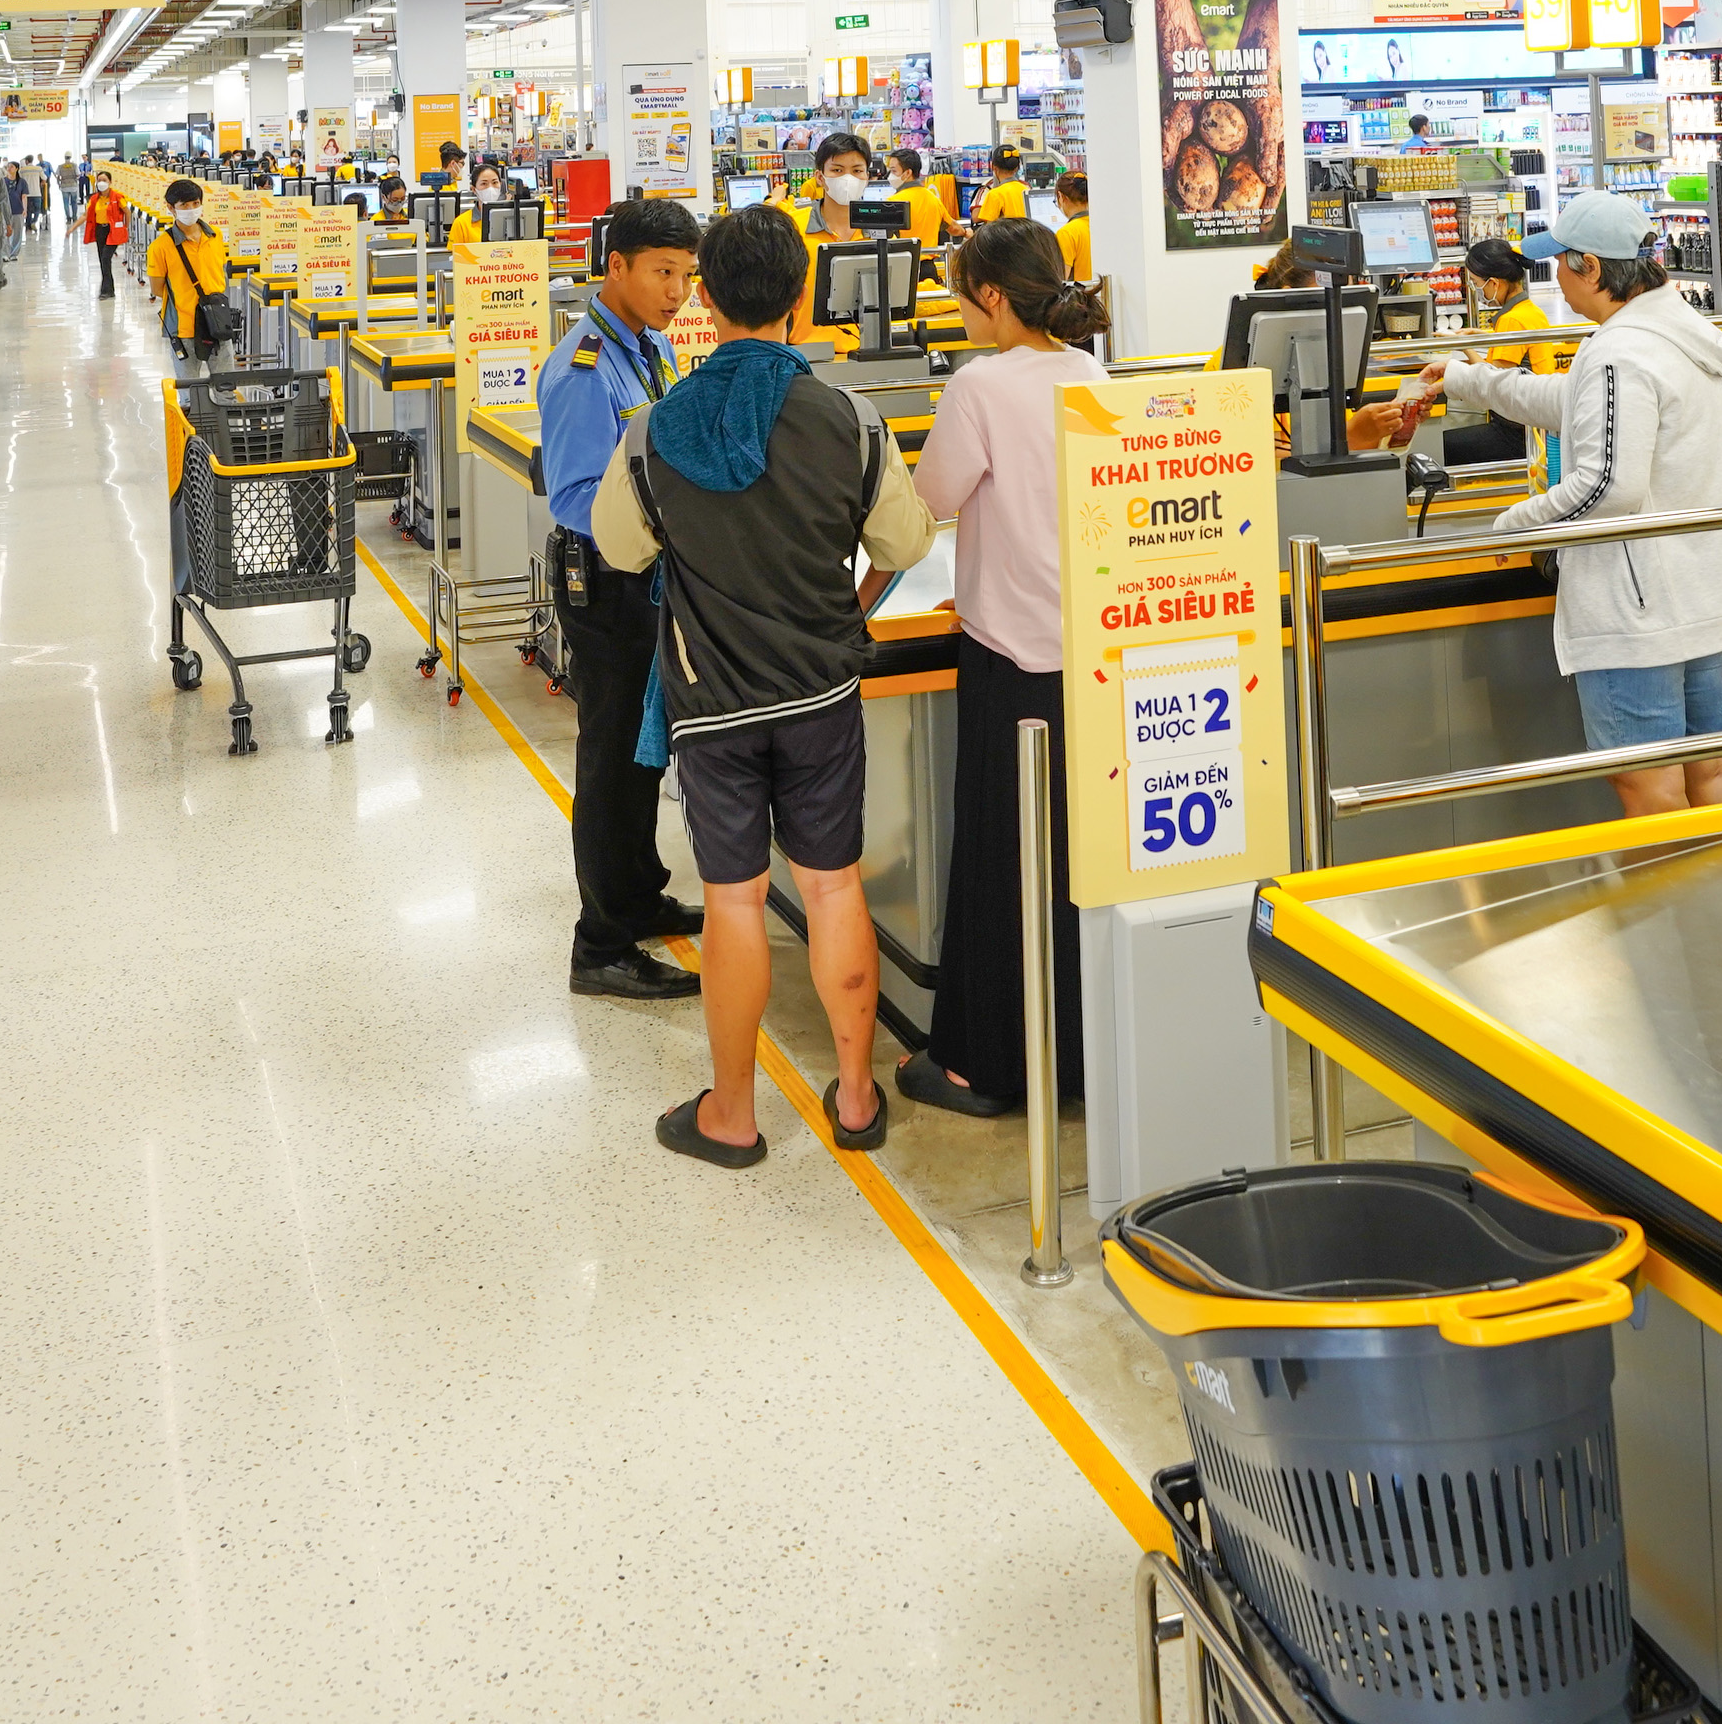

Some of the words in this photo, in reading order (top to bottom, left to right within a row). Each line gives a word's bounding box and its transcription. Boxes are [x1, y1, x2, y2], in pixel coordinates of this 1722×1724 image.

[1201, 3, 1234, 16] emart
[1172, 47, 1209, 73] SỨC
[1216, 49, 1267, 74] MẠNH
[1174, 90, 1201, 101] POWER
[1204, 90, 1213, 100] OF
[1216, 89, 1240, 99] LOCAL
[1242, 88, 1268, 99] FOODS
[1447, 98, 1468, 106] Brand
[314, 235, 342, 245] emart
[479, 264, 500, 272] TƯNG
[503, 261, 524, 271] BỪNG
[465, 276, 492, 285] KHAI
[495, 273, 539, 284] TRƯƠNG
[481, 288, 524, 303] emart
[513, 300, 524, 308] ÍCH
[674, 316, 703, 327] TƯNG
[469, 329, 492, 343] GIÁ
[494, 326, 521, 341] SIÊU
[524, 324, 538, 339] RẺ
[483, 370, 503, 379] MUA
[484, 378, 510, 389] ĐƯỢC
[514, 368, 526, 386] 2
[1121, 432, 1169, 453] TƯNG
[1174, 427, 1222, 450] BỪNG
[1091, 463, 1149, 487] KHAI
[1158, 451, 1254, 481] TRƯƠNG
[1126, 489, 1222, 529] emart
[1128, 533, 1166, 548] PHAN
[1169, 530, 1196, 544] HUY
[1200, 525, 1223, 541] ÍCH
[1118, 580, 1144, 594] HƠN
[1146, 575, 1177, 592] 300
[1179, 573, 1203, 588] SẢN
[1206, 568, 1237, 587] PHẨM
[1101, 594, 1153, 630] GIÁ
[1158, 590, 1219, 625] SIÊU
[1224, 581, 1255, 615] RẺ
[1134, 696, 1181, 719] MUA
[1187, 692, 1196, 713] 1
[1203, 687, 1231, 733] 2
[1137, 717, 1196, 744] ĐƯỢC
[1144, 767, 1190, 794] GIẢM
[1194, 761, 1229, 785] ĐẾN
[1143, 788, 1233, 854] 50%
